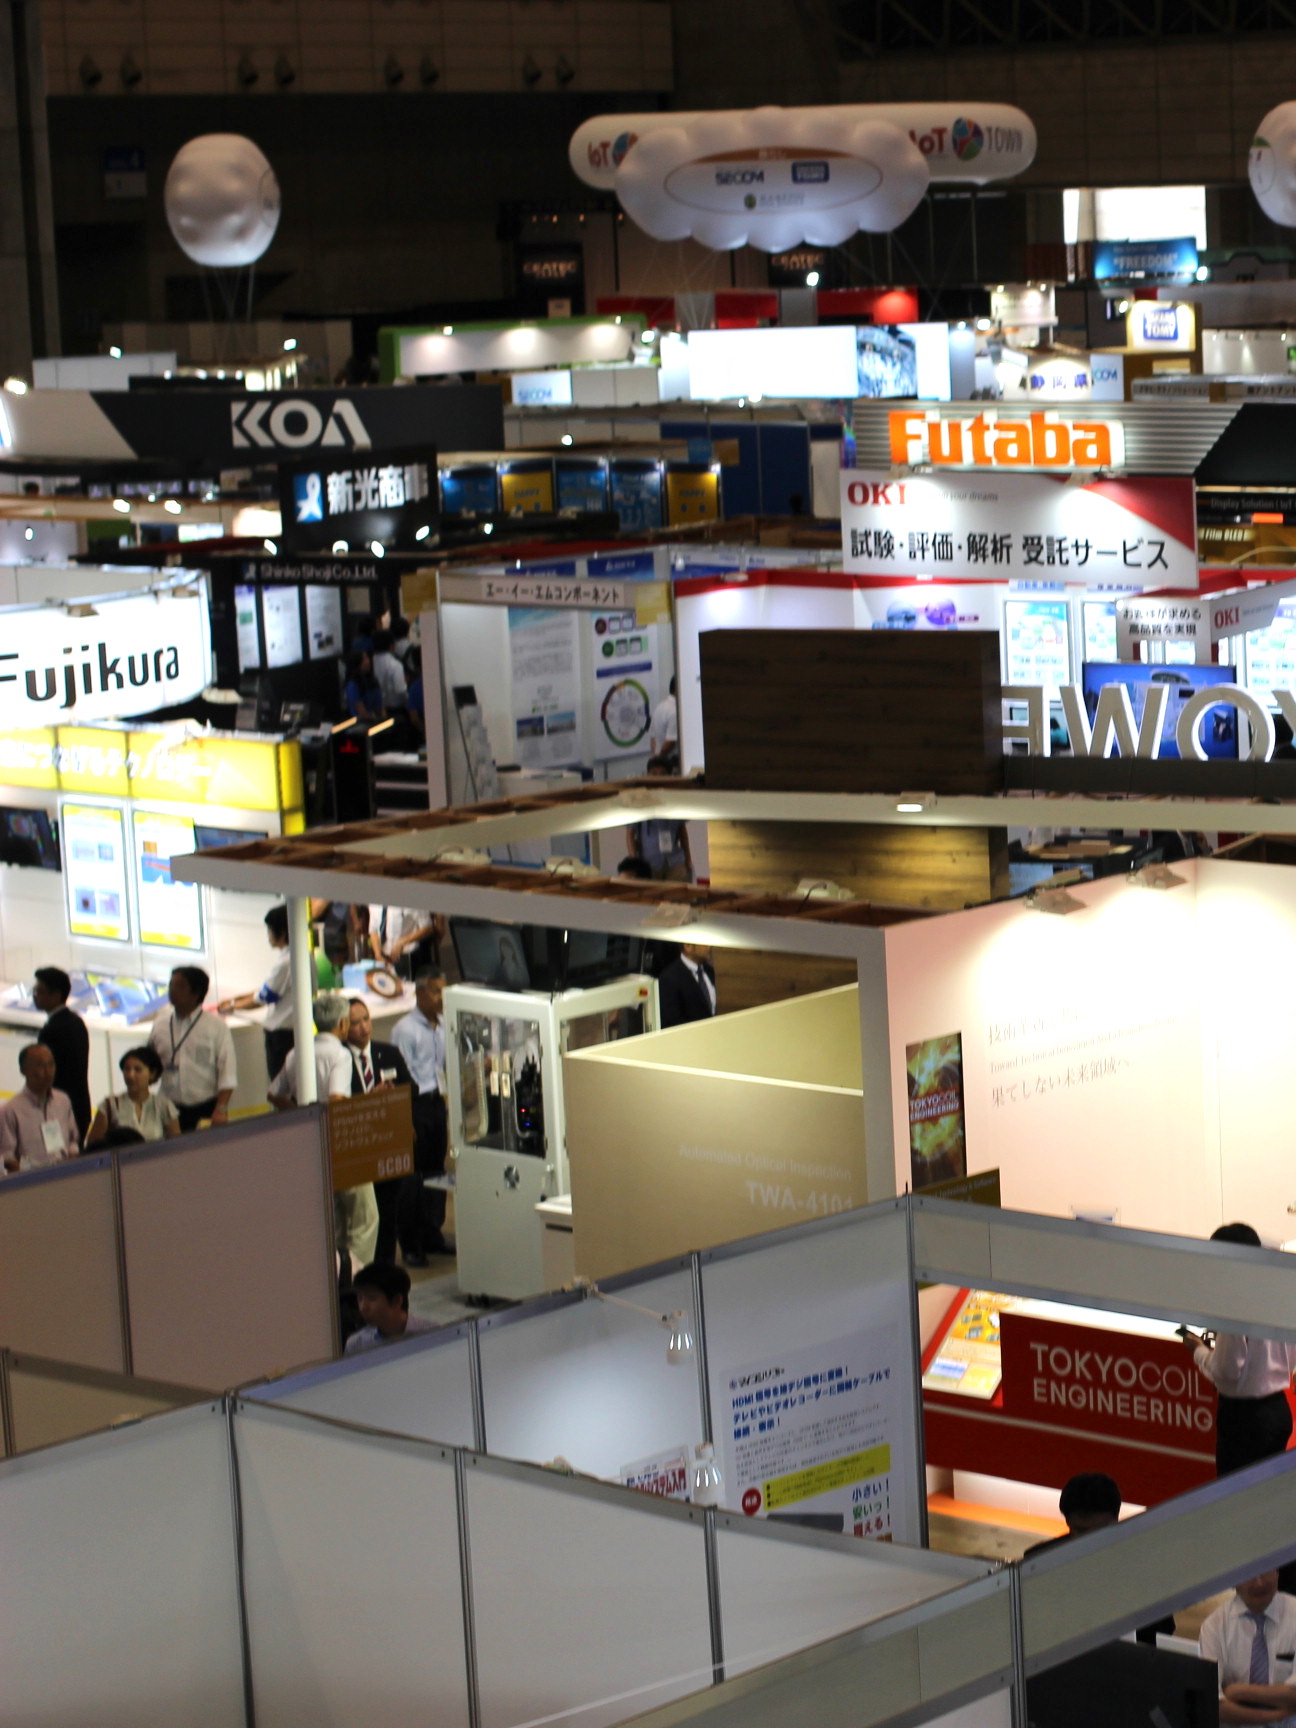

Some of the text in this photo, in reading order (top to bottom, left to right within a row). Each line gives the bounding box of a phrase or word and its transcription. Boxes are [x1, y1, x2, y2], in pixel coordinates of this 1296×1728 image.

[231, 400, 372, 449] KOA
[889, 410, 1113, 467] Futaba
[847, 481, 906, 506] OKI
[1022, 533, 1169, 569] 受託サービス
[1215, 606, 1240, 629] OKI
[0, 643, 180, 708] Fujikura
[679, 1143, 852, 1182] Automated Optical Inspection
[1033, 1378, 1213, 1432] ENGINEERING
